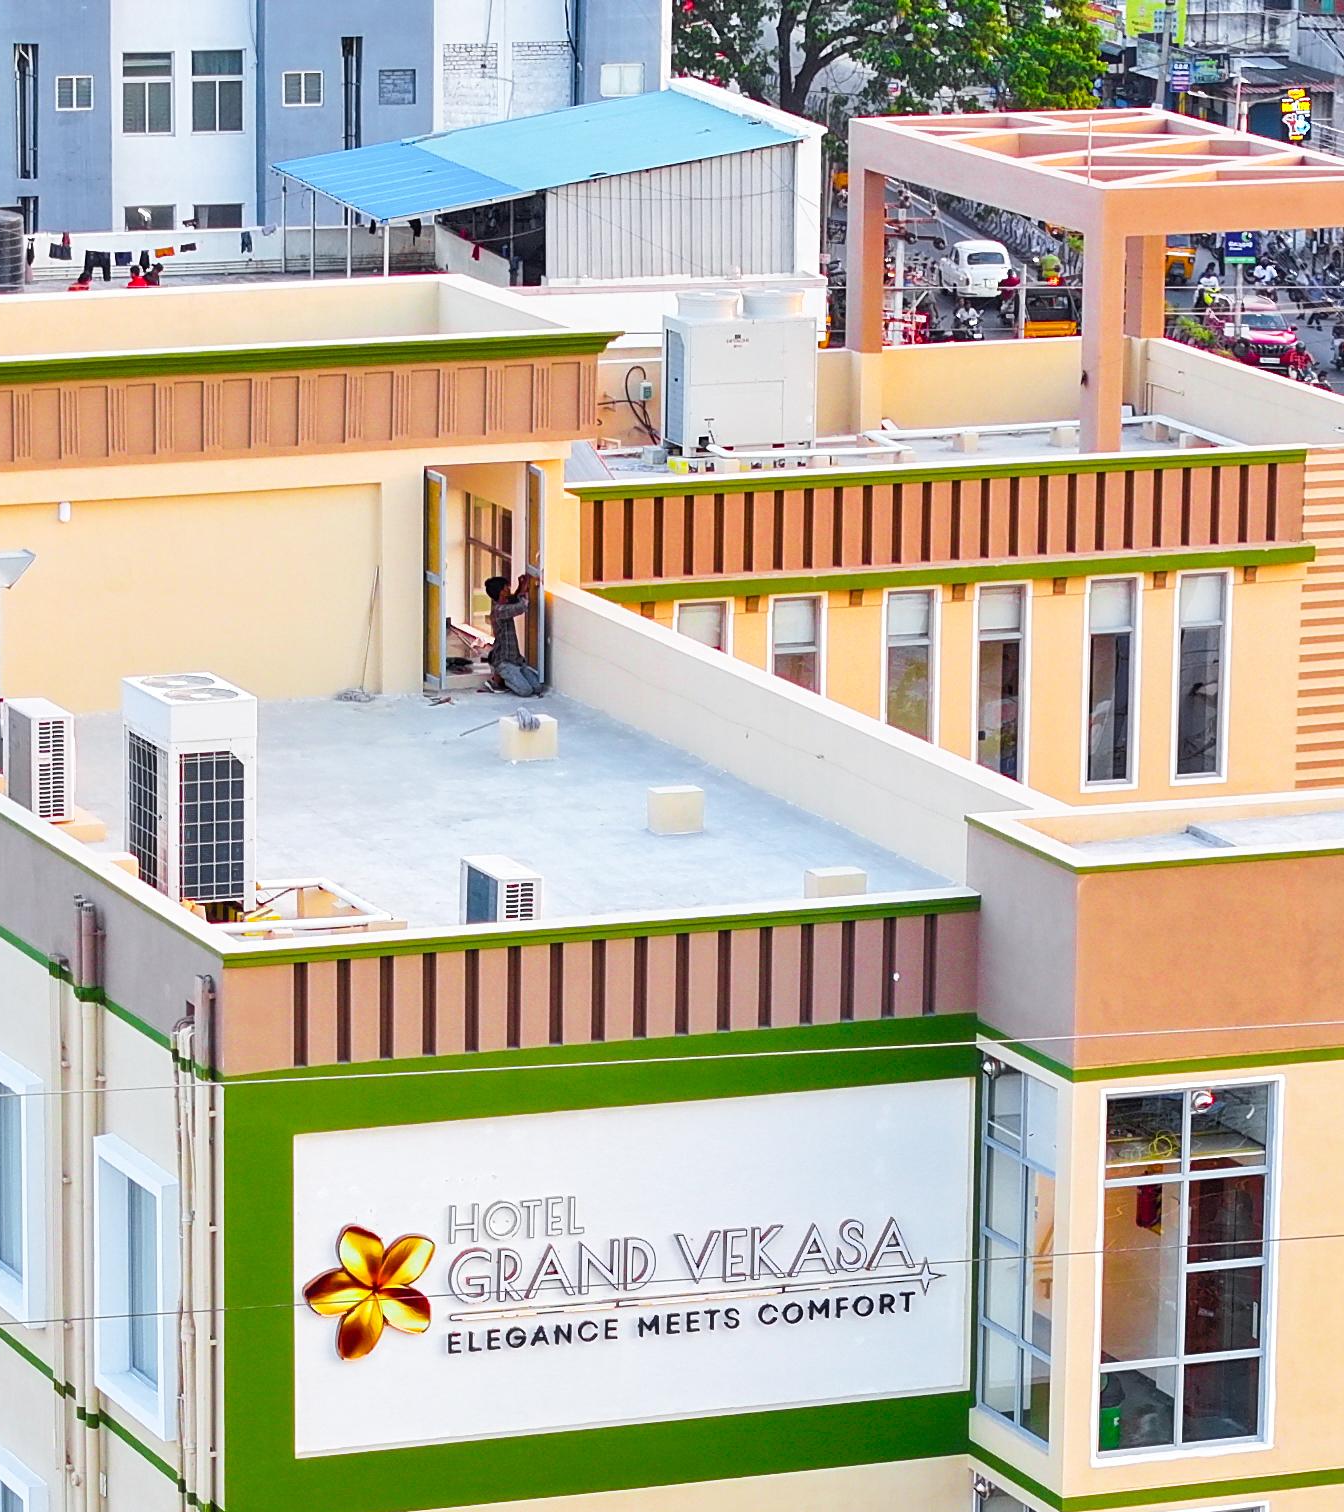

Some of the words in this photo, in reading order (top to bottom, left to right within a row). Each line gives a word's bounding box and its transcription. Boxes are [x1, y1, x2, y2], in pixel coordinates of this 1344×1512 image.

[448, 1196, 586, 1245] HOTEL
[448, 1237, 657, 1305] GRAND
[673, 1216, 916, 1284] VEKASA
[447, 1318, 619, 1354] ELEGANCE
[637, 1308, 741, 1338] MEETS
[757, 1291, 917, 1326] COMFORT
